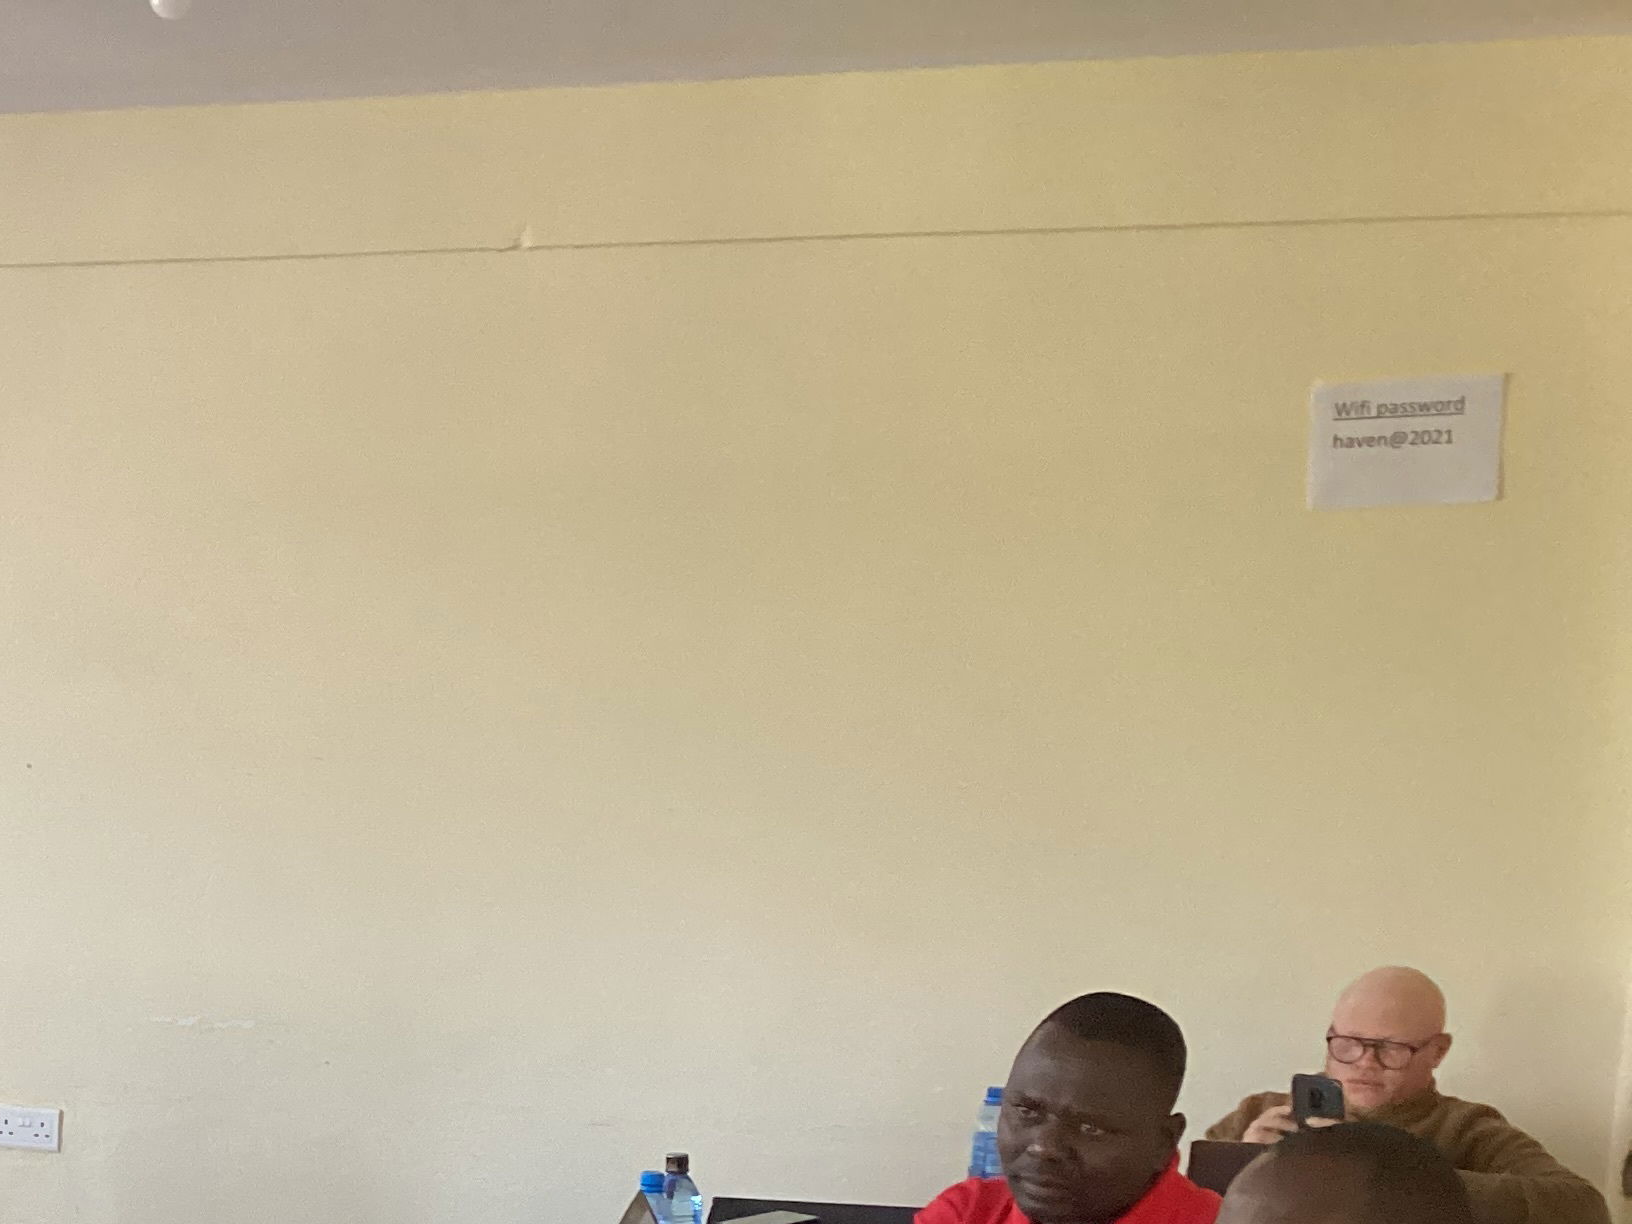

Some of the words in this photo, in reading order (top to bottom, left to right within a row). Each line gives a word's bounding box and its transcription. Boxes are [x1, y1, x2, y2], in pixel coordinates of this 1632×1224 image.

[1334, 400, 1372, 418] Wifi
[1376, 396, 1465, 417] password
[1332, 429, 1453, 449] haven@2021
